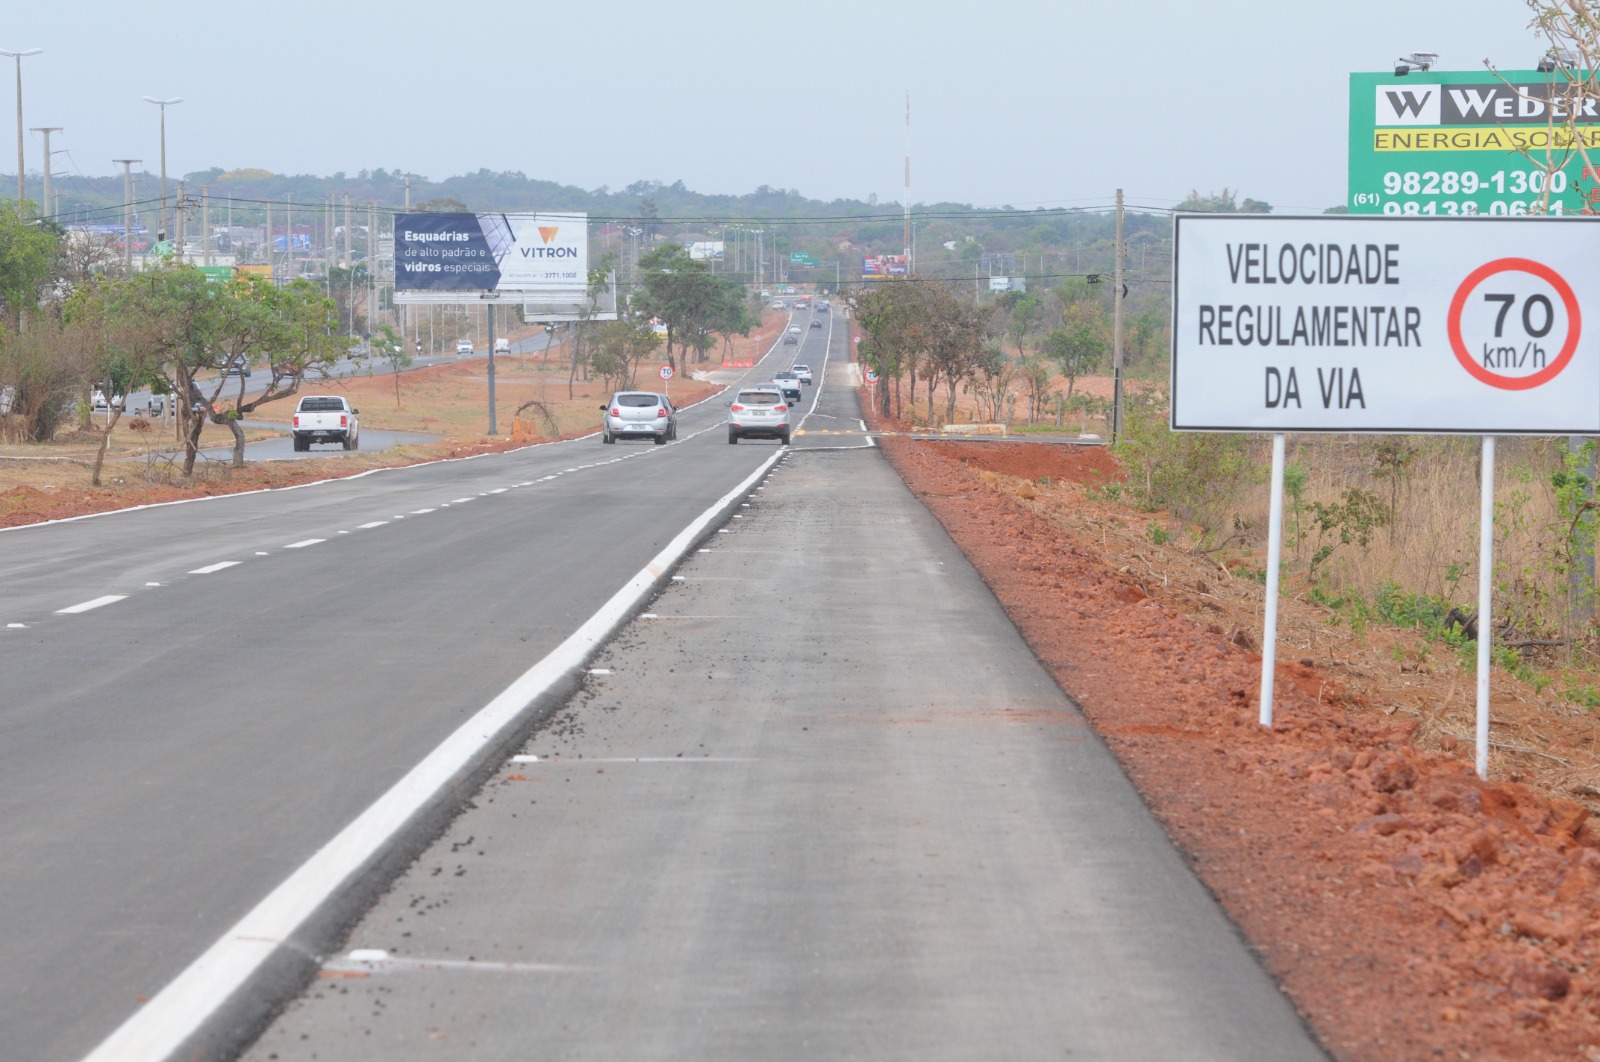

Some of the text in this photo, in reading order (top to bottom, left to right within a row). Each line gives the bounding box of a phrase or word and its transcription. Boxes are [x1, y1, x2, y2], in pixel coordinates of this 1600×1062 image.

[1385, 91, 1432, 119] W
[1375, 132, 1502, 149] ENERGIA
[1383, 170, 1567, 195] 98289-1300
[1353, 193, 1380, 206] (61)
[404, 231, 469, 243] Esquadrias
[404, 247, 486, 259] de alto padrão e
[520, 247, 578, 258] VITRON
[404, 261, 491, 275] vidros especiais
[1226, 243, 1399, 285] VELOCIDADE
[1199, 305, 1422, 347] REGULAMENTAR
[1484, 293, 1554, 339] 70
[1483, 341, 1547, 369] km/h
[662, 368, 672, 376] 70
[1265, 366, 1366, 409] DA VIA
